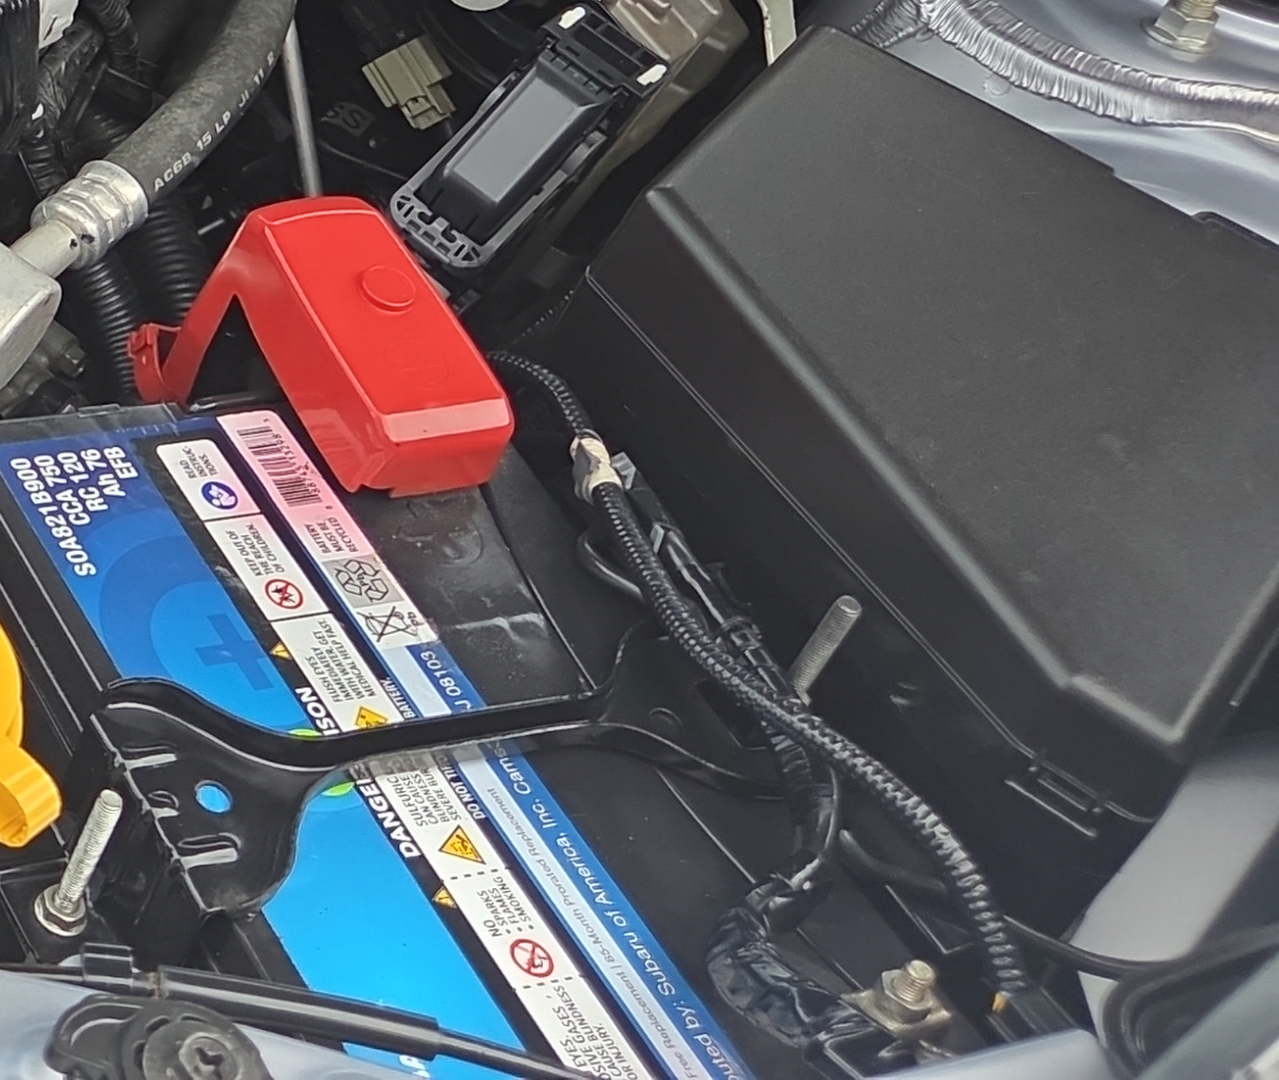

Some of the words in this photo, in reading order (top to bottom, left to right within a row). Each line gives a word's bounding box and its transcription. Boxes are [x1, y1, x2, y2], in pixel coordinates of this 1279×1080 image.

[149, 150, 194, 192] AC6B
[193, 130, 215, 151] 15
[32, 454, 68, 486] 750
[56, 451, 91, 483] 120
[79, 447, 109, 469] 76
[103, 445, 139, 478] EFB
[179, 460, 196, 478] READ
[182, 448, 207, 477] INSTRUC-
[198, 453, 217, 475] TIONS.
[79, 483, 109, 510] RC
[94, 472, 126, 496] Ah
[56, 487, 91, 524] CCA
[225, 530, 238, 539] OF
[304, 524, 330, 553] BATTERY
[316, 522, 329, 530] BE
[327, 517, 358, 552] RECYCLED
[233, 541, 249, 556] OUT
[241, 534, 261, 558] REACH
[246, 524, 276, 561] CHILDREN.
[323, 532, 343, 551] MUST
[244, 557, 262, 576] KEEP
[258, 560, 273, 574] THE
[272, 563, 284, 572] OF
[356, 574, 369, 586] Pb
[318, 620, 336, 638] FAST.
[407, 611, 423, 626] Pb
[312, 630, 328, 645] GET
[331, 641, 350, 658] HELP
[305, 656, 324, 674] EYES
[311, 647, 353, 700] IMMEDIATELY
[325, 648, 349, 675] WATER.
[420, 651, 461, 695] 08103
[319, 676, 342, 702] FLUSH
[344, 677, 364, 698] WITH
[346, 661, 375, 696] MEDICAL
[380, 677, 415, 717] BATTERY.
[386, 776, 428, 826] SULFURIC
[400, 776, 424, 803] CAUSE
[410, 773, 449, 822] BLINDNESS
[452, 783, 473, 801] NOT
[420, 806, 438, 823] CAN
[433, 789, 461, 819] SEVERE
[467, 805, 485, 819] DO
[532, 798, 556, 826] Inc.
[487, 788, 536, 854] Replacement
[556, 832, 608, 902] America,
[535, 858, 574, 905] Prorated
[477, 890, 507, 925] SPARKS
[487, 887, 519, 922] FLAMES
[493, 876, 530, 921] SMOKING
[483, 919, 502, 937] NO
[607, 910, 628, 927] of
[573, 912, 610, 956] 85-Month
[624, 932, 674, 994] Subaru
[552, 1006, 585, 1040] GASES
[553, 985, 598, 1039] BLINDNESS
[616, 971, 675, 1048] Replacement
[673, 1001, 700, 1028] by:
[559, 1035, 587, 1067] EYES.
[593, 1023, 626, 1062] INJURY.
[593, 1045, 621, 1076] CAUSE
[621, 1066, 641, 1080] OR
[674, 1054, 697, 1077] Free
